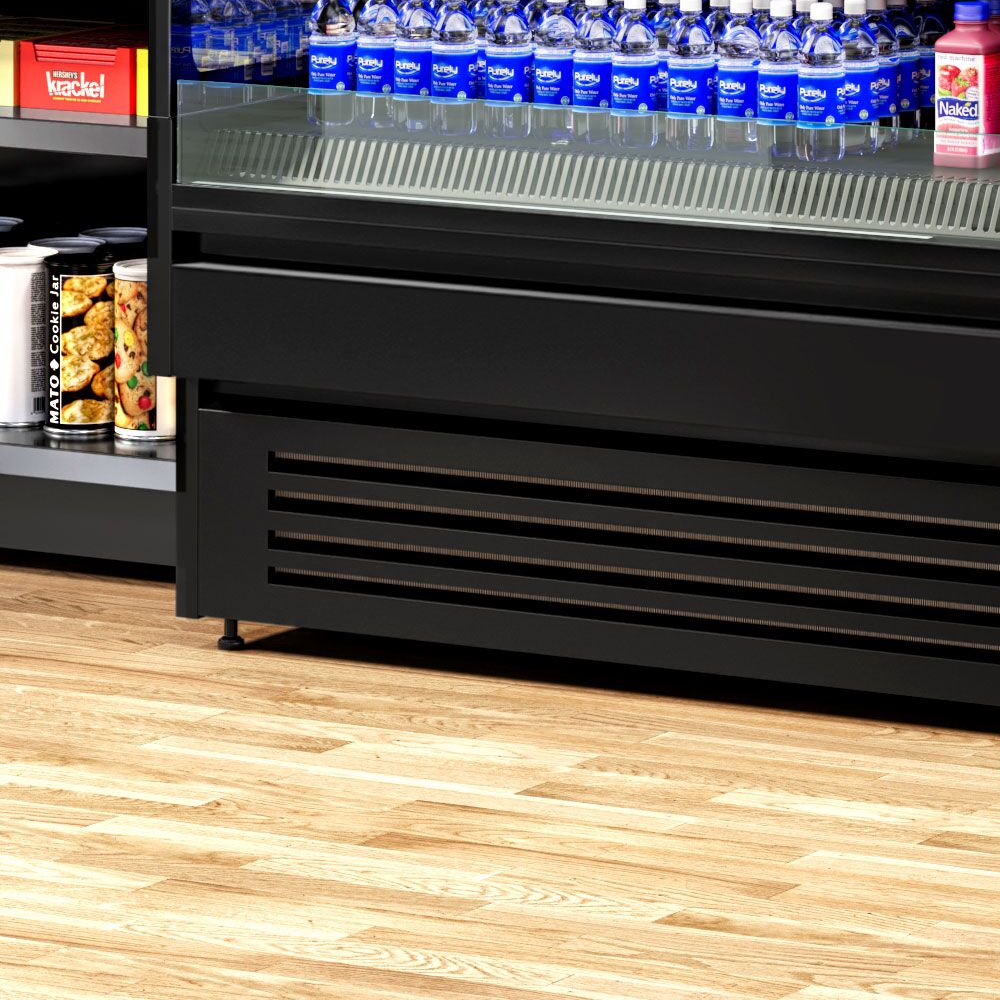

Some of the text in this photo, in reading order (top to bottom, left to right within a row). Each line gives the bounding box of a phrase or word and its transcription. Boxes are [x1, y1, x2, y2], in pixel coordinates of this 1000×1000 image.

[311, 55, 337, 65] Purely
[358, 57, 383, 67] Purely
[433, 64, 458, 74] Purely
[488, 66, 514, 76] Purely
[53, 71, 78, 79] HERSHEY'S
[574, 71, 601, 82] Purely
[46, 71, 105, 98] krackel
[613, 75, 639, 87] Purely
[670, 78, 698, 89] Purely
[720, 79, 745, 91] Purely
[760, 83, 786, 95] Purely
[800, 87, 826, 98] Purely
[50, 275, 60, 424] MATO Cookie Jar
